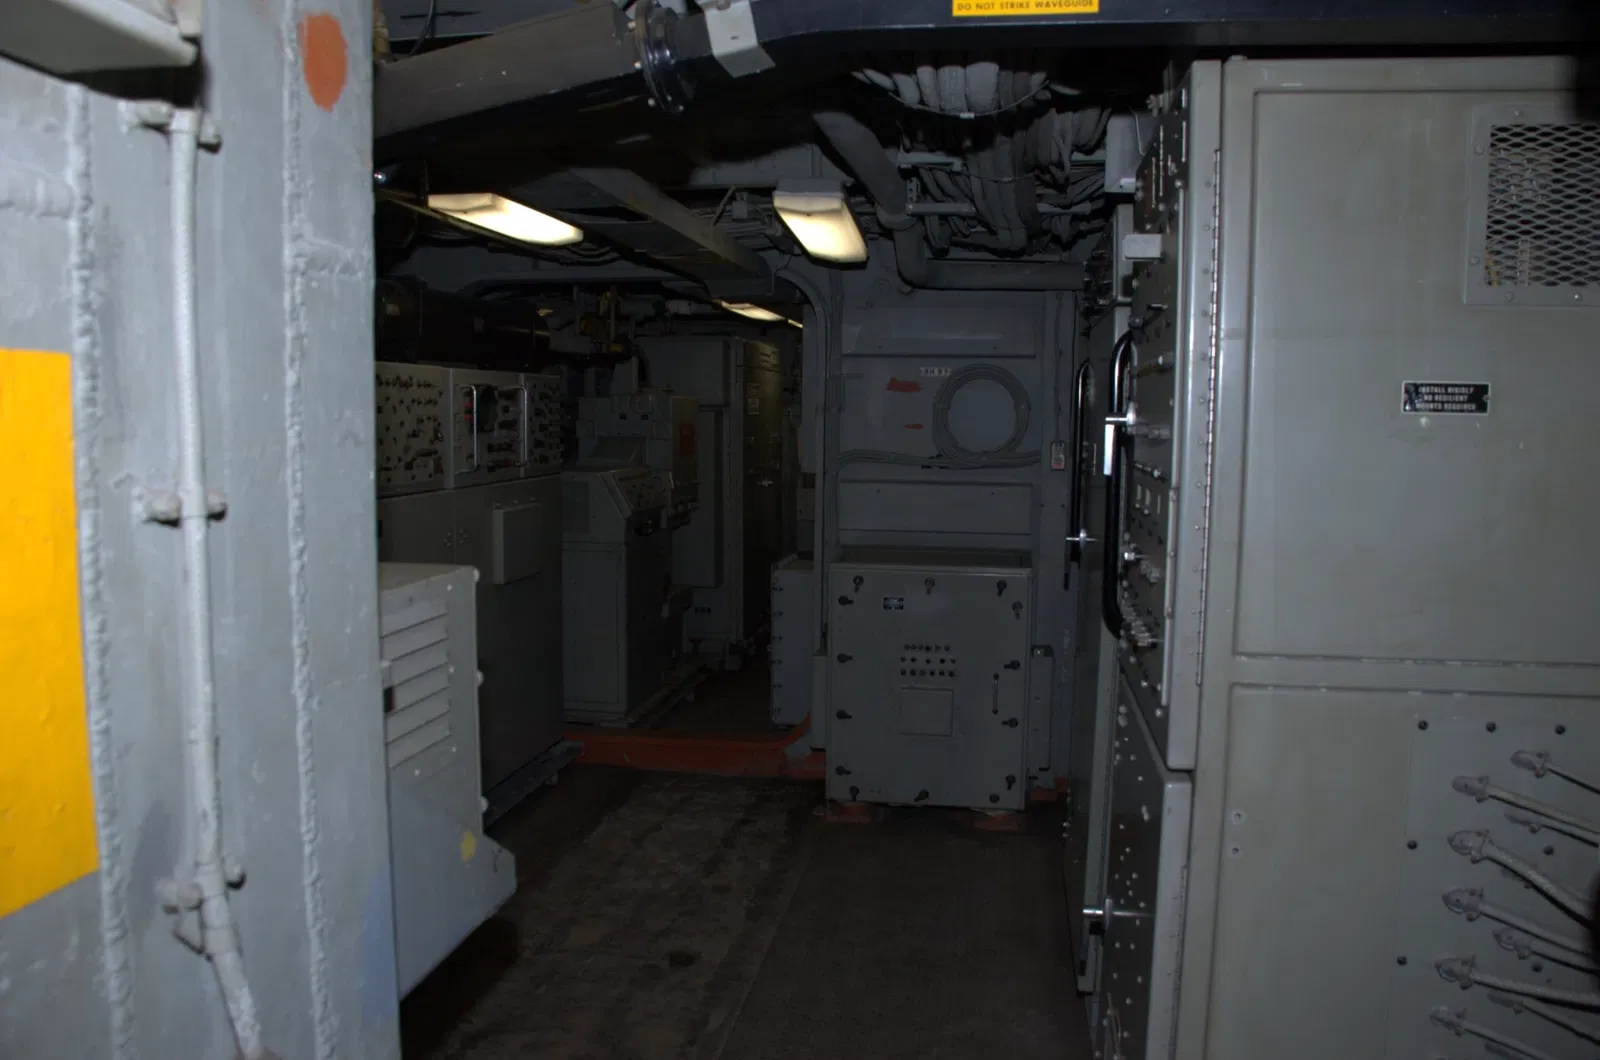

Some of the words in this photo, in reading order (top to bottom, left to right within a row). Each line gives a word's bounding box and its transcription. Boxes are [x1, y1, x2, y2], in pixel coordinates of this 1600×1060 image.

[957, 3, 971, 11] DO
[976, 2, 995, 10] NOT
[1000, 1, 1030, 9] STRIKE
[1035, 0, 1093, 8] WAVEGUIDE
